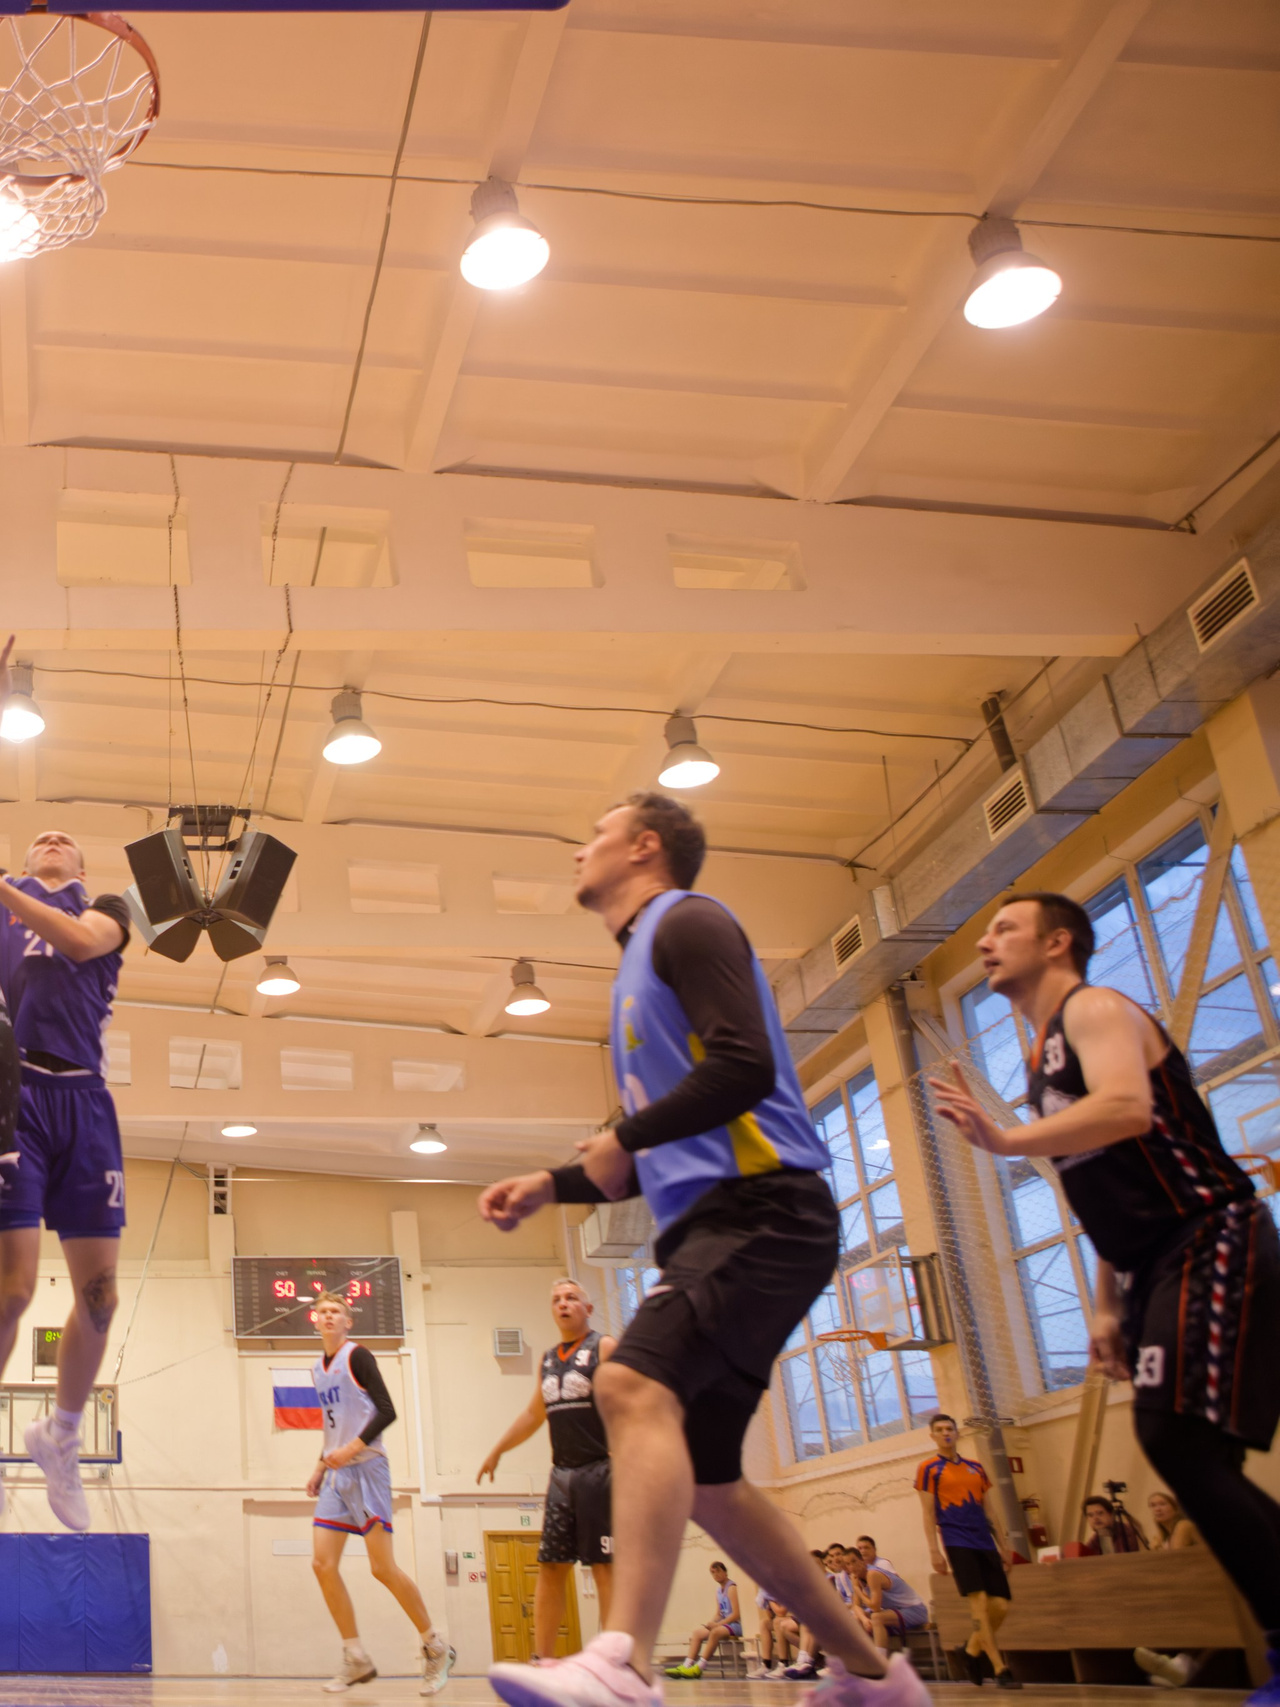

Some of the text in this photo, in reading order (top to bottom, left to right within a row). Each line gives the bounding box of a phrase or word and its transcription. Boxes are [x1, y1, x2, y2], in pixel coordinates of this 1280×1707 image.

[274, 1280, 295, 1297] 50
[349, 1280, 371, 1297] 31
[327, 1409, 336, 1429] 5
